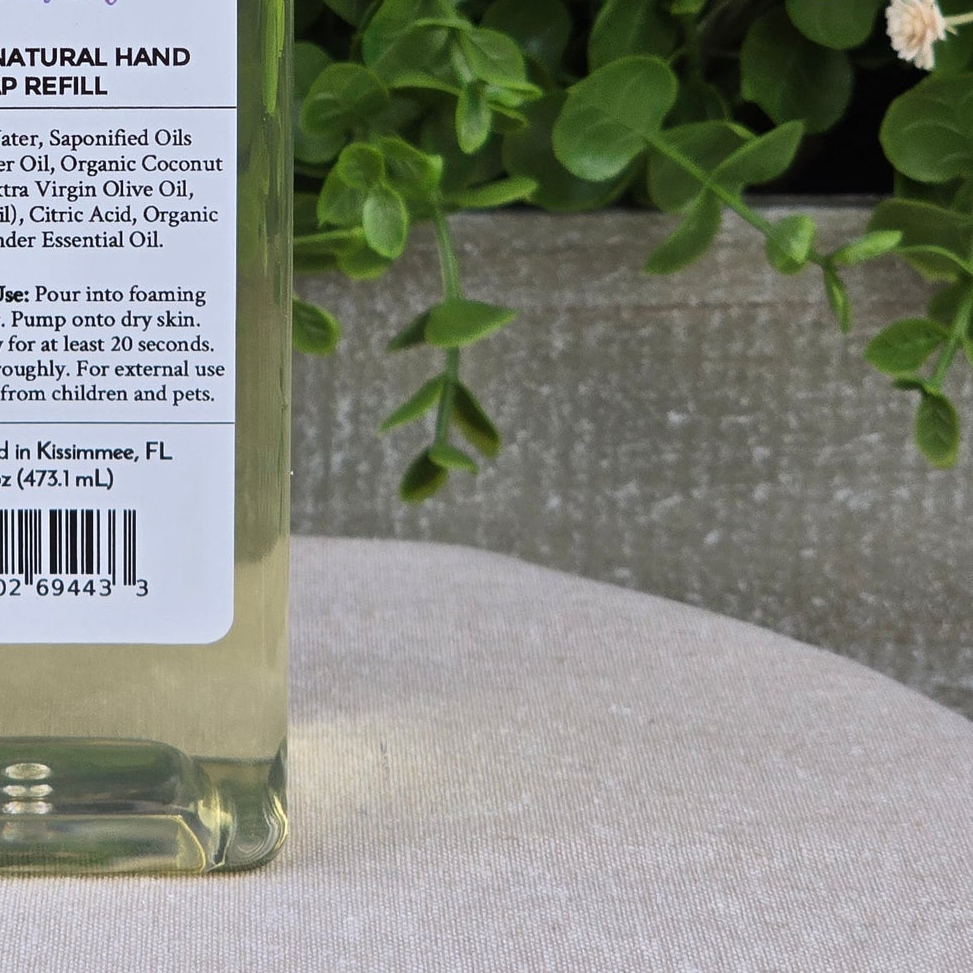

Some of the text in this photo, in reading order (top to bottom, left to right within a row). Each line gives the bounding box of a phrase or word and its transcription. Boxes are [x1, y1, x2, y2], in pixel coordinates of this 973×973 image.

[115, 47, 190, 67] HAND
[25, 76, 108, 96] REFILL
[48, 129, 149, 152] Saponified
[155, 129, 193, 146] Oils
[20, 154, 55, 176] Oil,
[60, 154, 136, 176] Organic
[142, 154, 223, 176] Coconut
[34, 180, 97, 201] Virgin
[102, 180, 153, 200] Olive
[159, 180, 194, 201] Oil,
[29, 206, 84, 227] Citric
[88, 205, 137, 227] Acid,
[143, 205, 218, 227] Organic
[41, 230, 125, 251] Essential
[129, 230, 163, 248] Oil.
[35, 285, 81, 306] Pour
[86, 286, 124, 306] into
[128, 285, 206, 306] foaming
[11, 310, 66, 331] Pump
[72, 313, 116, 331] onto
[121, 310, 153, 331] dry
[157, 310, 200, 331] skin.
[7, 335, 36, 352] for
[41, 338, 59, 352] at
[62, 335, 105, 354] least
[111, 335, 133, 352] 20
[138, 335, 214, 355] seconds.
[76, 360, 110, 380] For
[114, 360, 189, 377] external
[193, 362, 225, 377] use
[0, 384, 46, 401] from
[52, 384, 128, 401] children
[134, 384, 167, 402] and
[172, 388, 214, 407] pets.
[15, 444, 30, 460] in
[37, 441, 139, 463] Kissimmee,
[146, 441, 173, 460] FL
[17, 467, 69, 491] (473.1
[76, 467, 113, 490] mL)
[36, 579, 112, 597] 69443
[137, 579, 148, 597] 3
